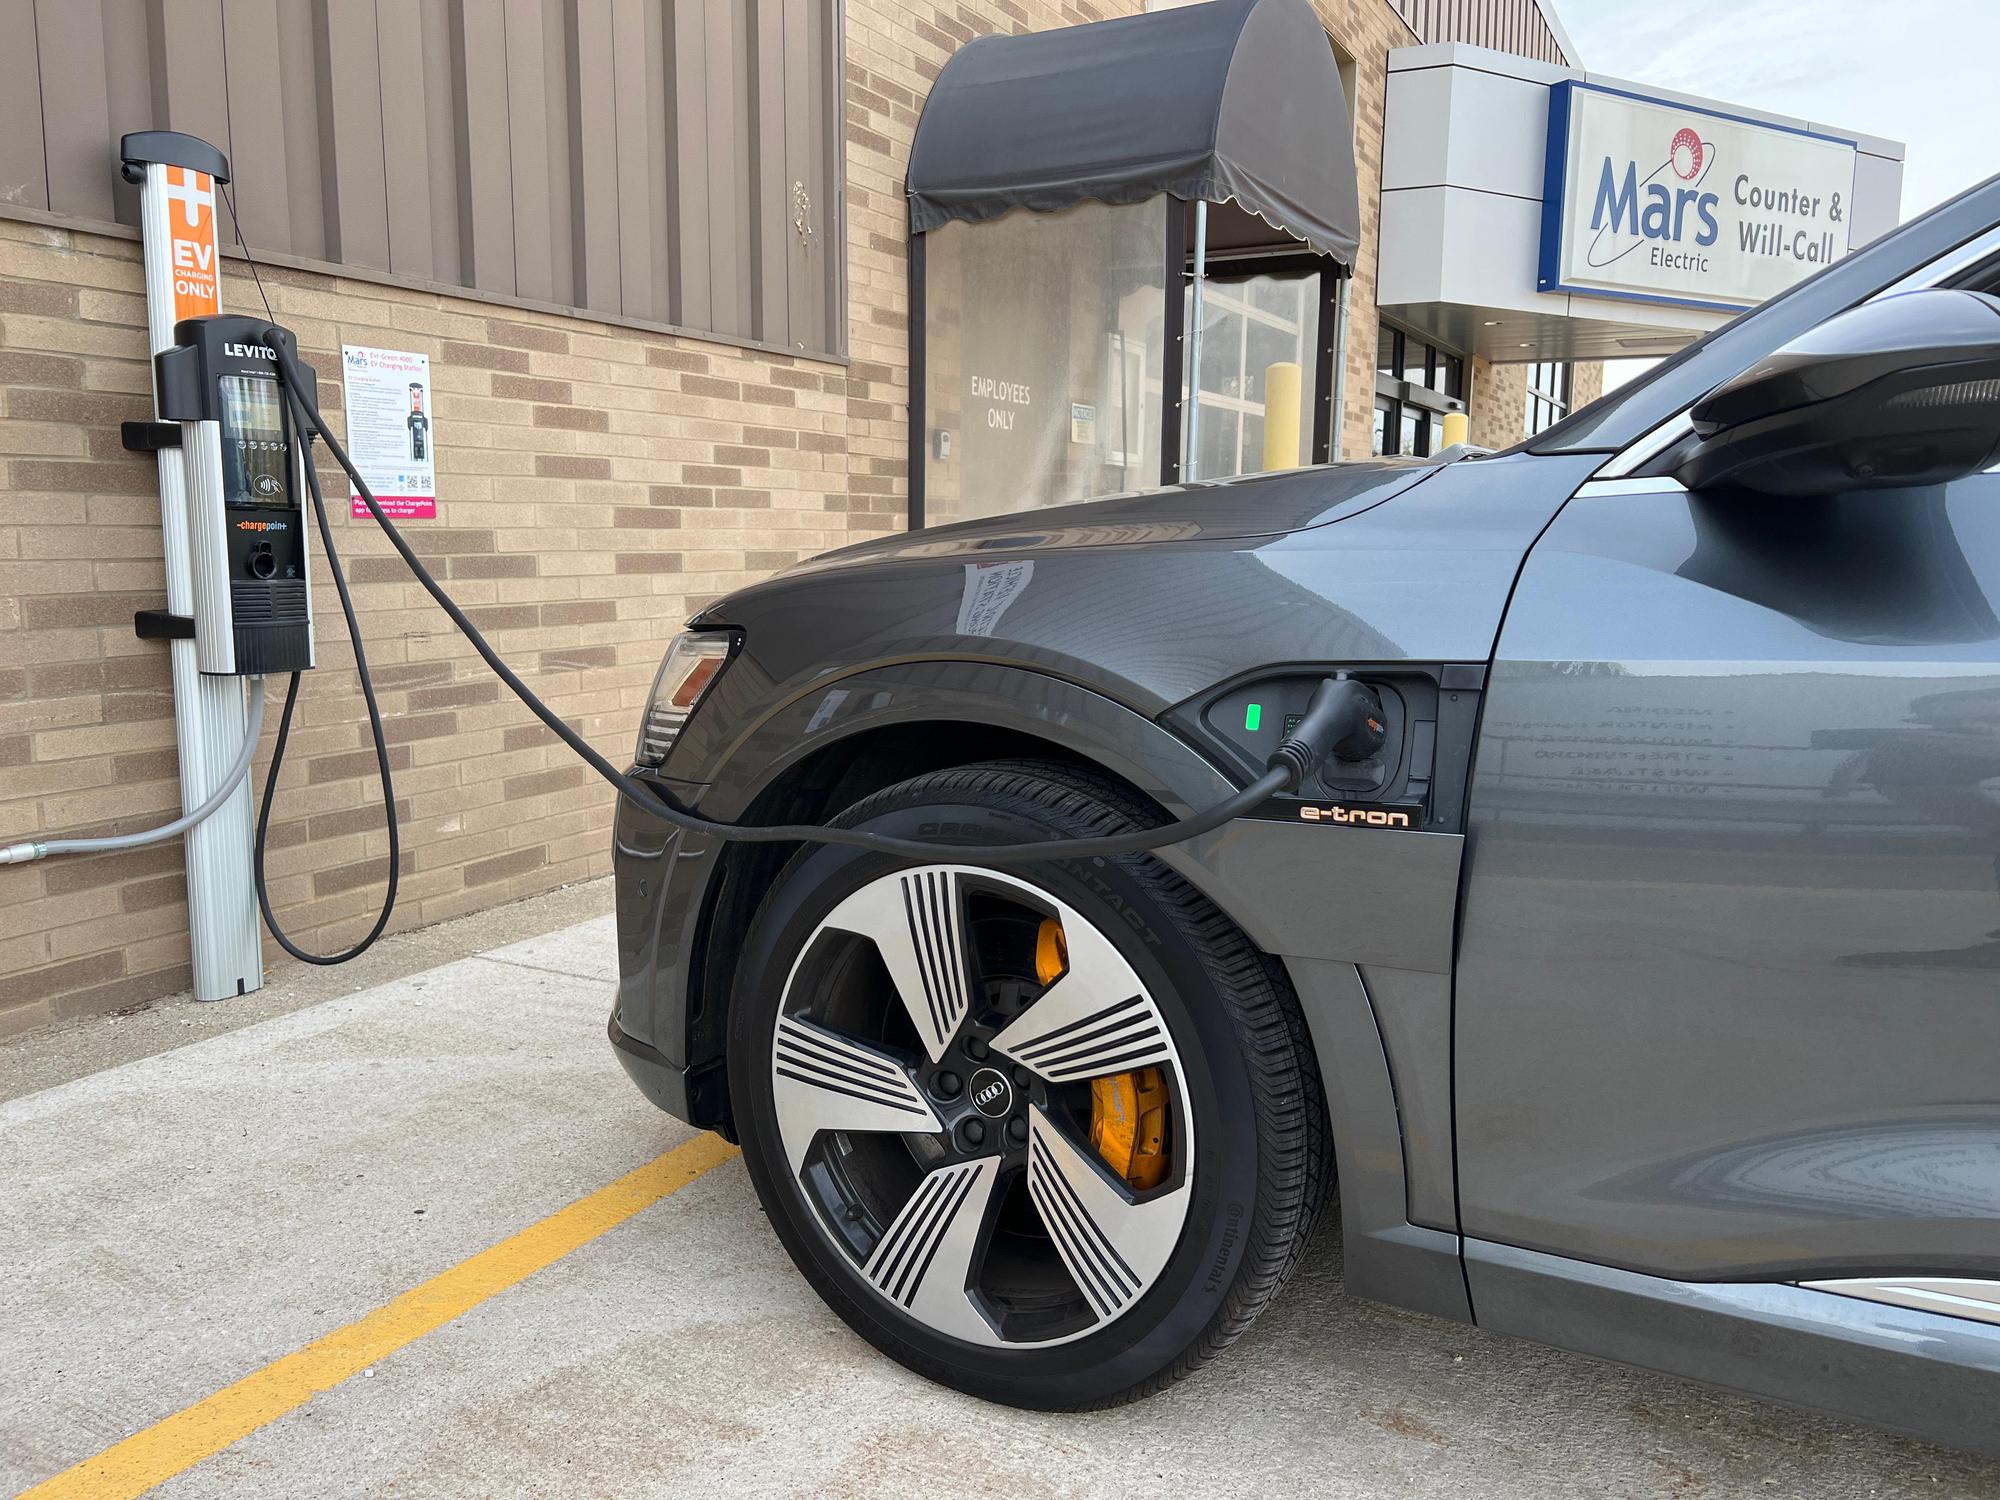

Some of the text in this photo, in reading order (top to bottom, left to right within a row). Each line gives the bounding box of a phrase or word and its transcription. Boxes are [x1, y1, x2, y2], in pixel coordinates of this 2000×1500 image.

[1590, 156, 1720, 247] Mars
[1734, 174, 1842, 222] Counter &
[173, 238, 212, 270] EV
[1738, 220, 1833, 264] Will-Call
[1650, 247, 1709, 273] Electric
[175, 269, 214, 281] CHARGING
[175, 280, 215, 299] ONLY
[224, 342, 278, 361] LEVITO
[347, 355, 368, 366] Mars
[379, 362, 402, 371] Charging
[971, 375, 1031, 405] EMPLOYEES
[987, 408, 1016, 430] ONLY
[1299, 805, 1409, 827] e-tron
[1207, 1200, 1245, 1288] Continental
